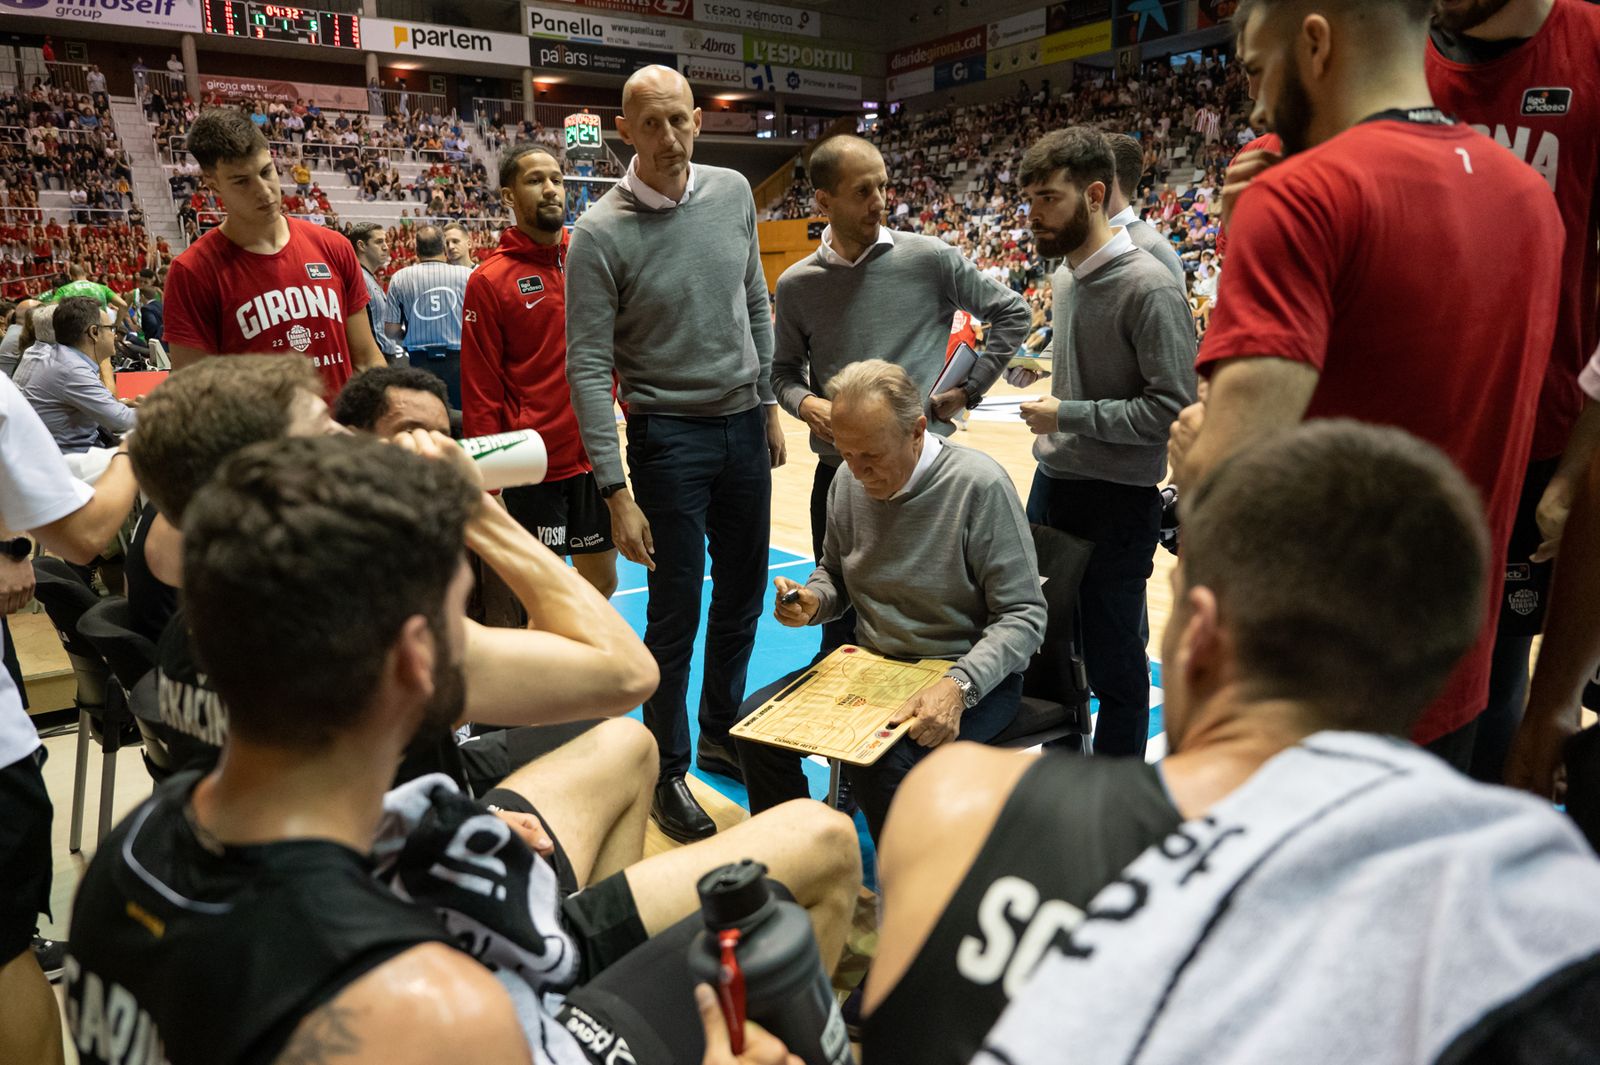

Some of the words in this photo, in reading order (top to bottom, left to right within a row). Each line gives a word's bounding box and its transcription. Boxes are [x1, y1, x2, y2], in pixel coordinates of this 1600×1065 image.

[55, 6, 103, 20] group
[265, 5, 301, 19] 04:32
[531, 12, 603, 37] Panella
[411, 28, 492, 51] parlem
[753, 41, 853, 70] L'ESPORTIU
[206, 81, 239, 91] girona
[1525, 103, 1566, 112] endesa
[1527, 96, 1546, 105] liga
[579, 124, 598, 142] 24
[430, 295, 441, 312] 5
[236, 285, 343, 340] GIRONA
[465, 309, 477, 323] 23
[272, 339, 284, 347] 22
[314, 331, 326, 339] 23
